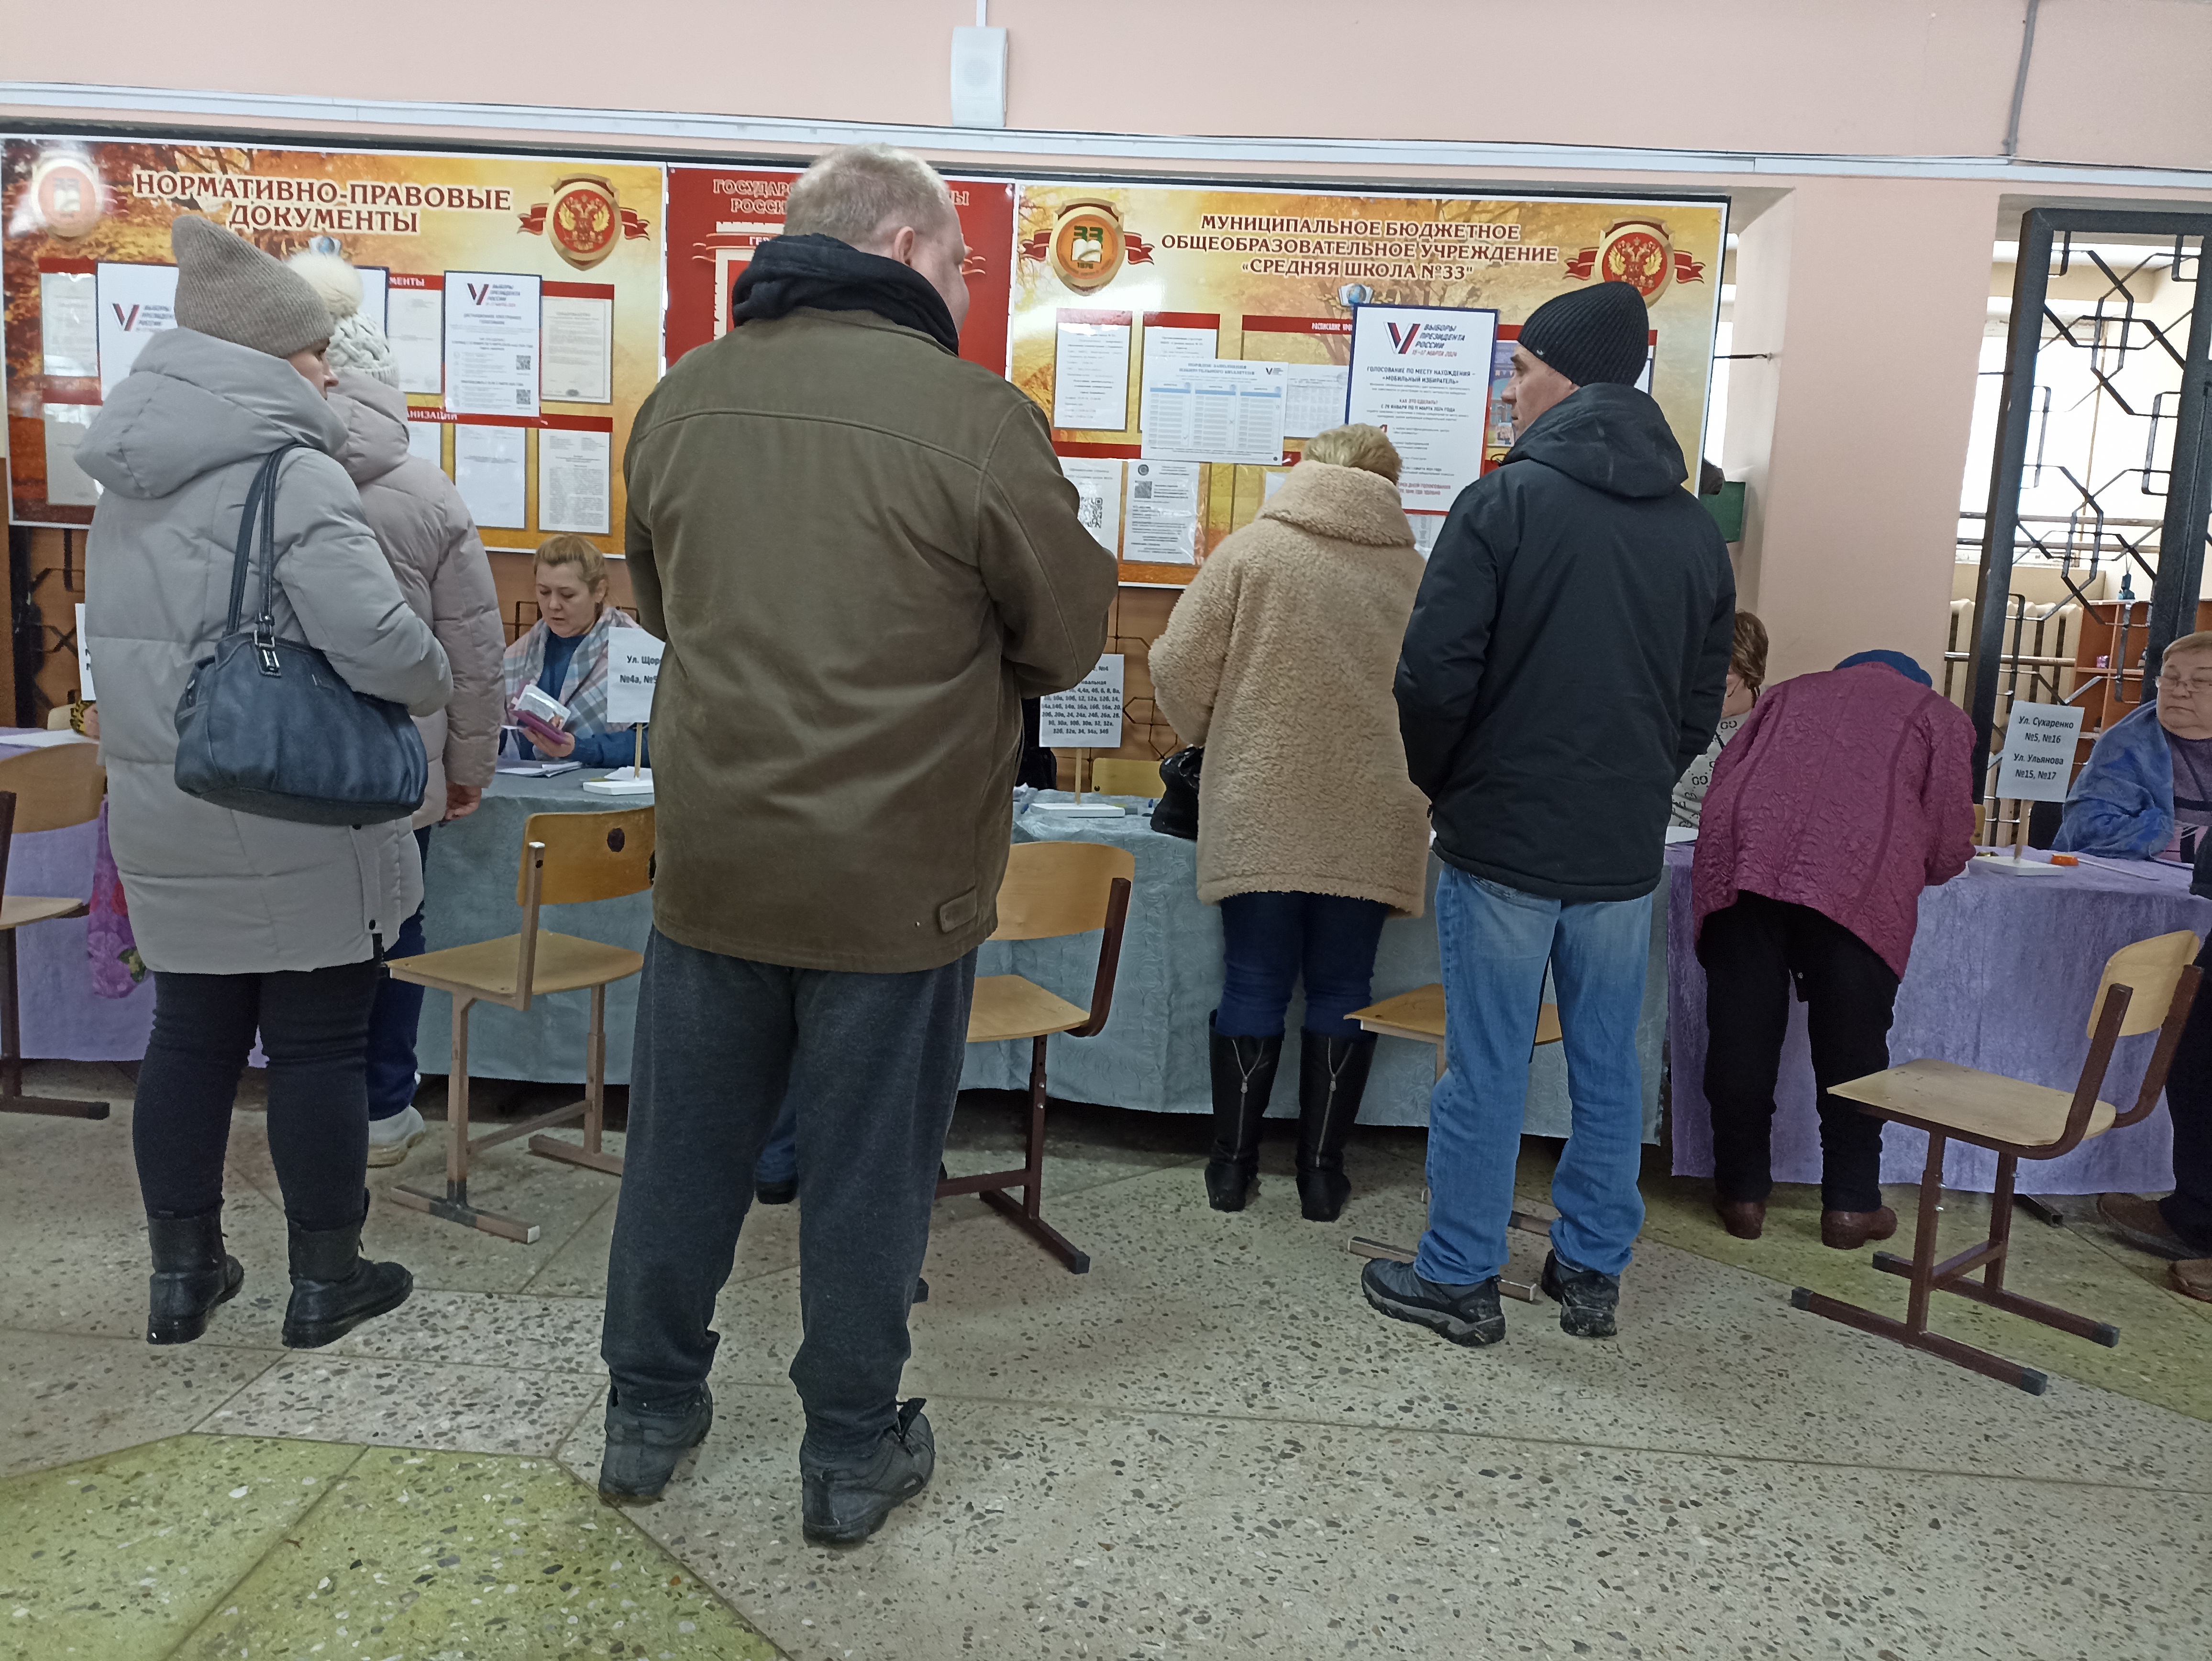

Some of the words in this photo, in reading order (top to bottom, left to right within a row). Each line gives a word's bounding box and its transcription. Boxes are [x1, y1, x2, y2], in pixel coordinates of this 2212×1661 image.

[136, 173, 511, 210] НОРМАТИВНО-ПРАВОВЫЕ
[731, 198, 787, 215] РОССИ
[229, 204, 417, 233] ДОКУМЕНТЫ
[1073, 225, 1104, 244] 33
[1201, 215, 1380, 236] МУНИЦИПАЛЬНОЕ
[1386, 221, 1520, 240] БЮДЖЕТНОЕ
[1161, 234, 1415, 257] ОБЩЕОБРАЗОВАТЕЛЬНОЕ
[1421, 244, 1558, 263] УЧРЕЖДЕНИЕ
[1242, 258, 1339, 277] «СРЕДНЯЯ
[1345, 262, 1416, 278] ШКОЛА
[389, 277, 425, 287] МЕНТЫ
[627, 655, 640, 664] Ул.
[641, 656, 661, 665] Щор
[2018, 715, 2030, 725] Ул.
[2033, 717, 2074, 729] Сухаренко
[2024, 732, 2040, 742] №5,
[2042, 734, 2061, 743] №16
[2013, 753, 2025, 762] Ул.
[2027, 754, 2064, 765] Ульянова
[2015, 769, 2035, 779] №15,
[2038, 771, 2057, 780] №17
